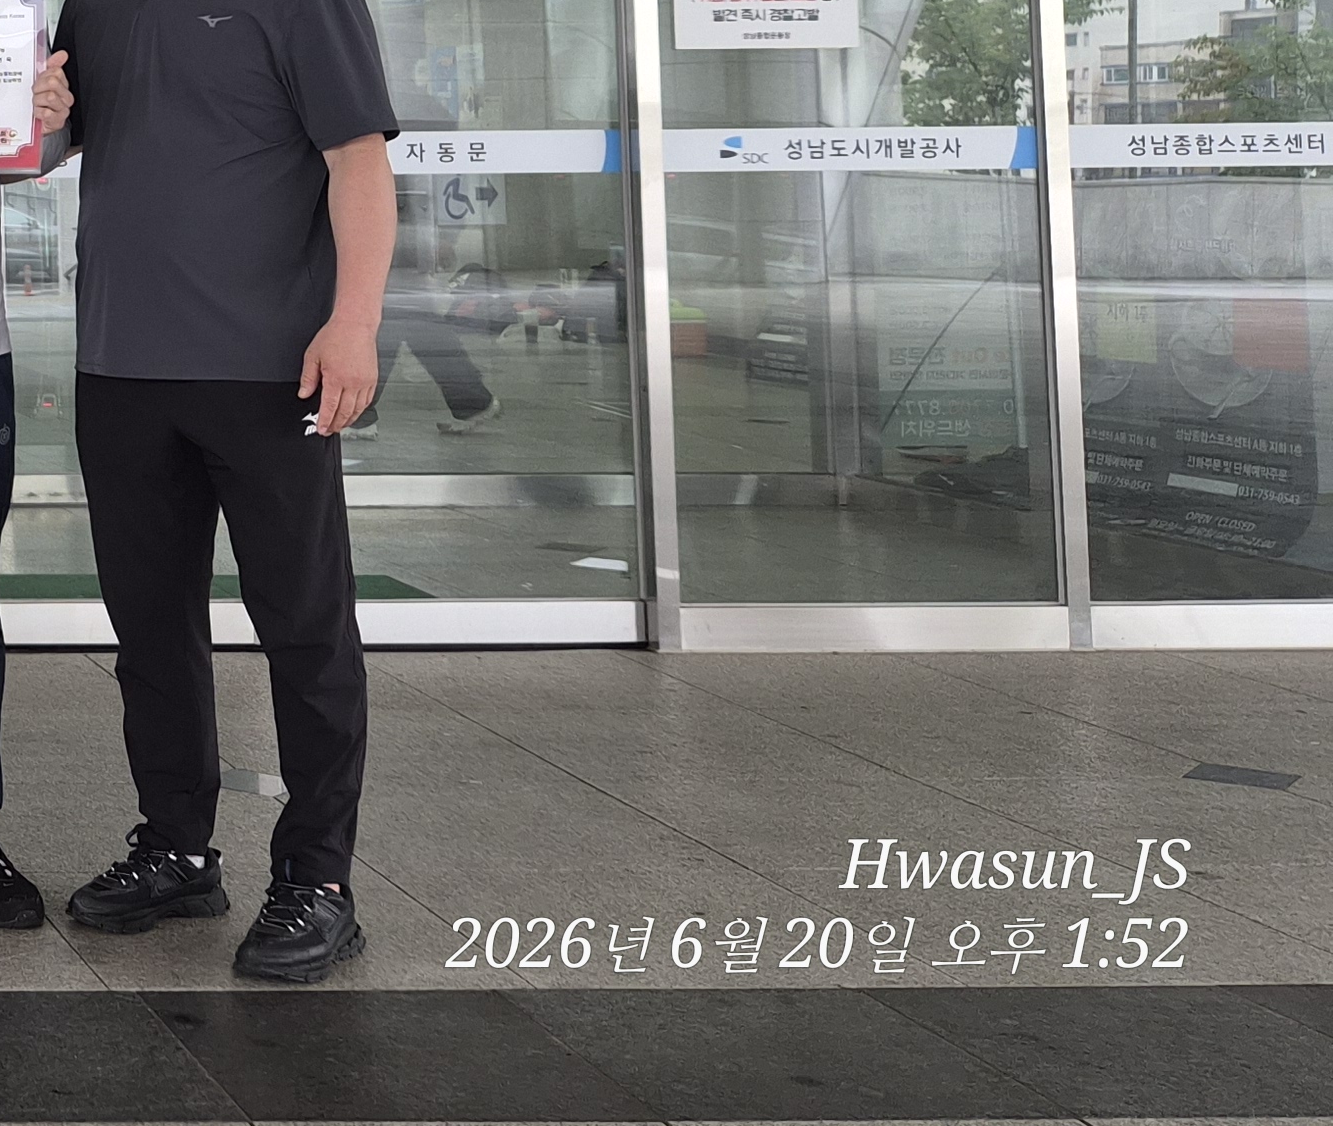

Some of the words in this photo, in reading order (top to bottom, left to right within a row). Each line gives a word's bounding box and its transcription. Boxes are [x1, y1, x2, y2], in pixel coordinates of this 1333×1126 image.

[406, 142, 488, 163] 자동문
[784, 137, 962, 160] 성남도시개발공사
[1127, 133, 1326, 157] 성남종합스포츠센터
[741, 153, 769, 164] SDC
